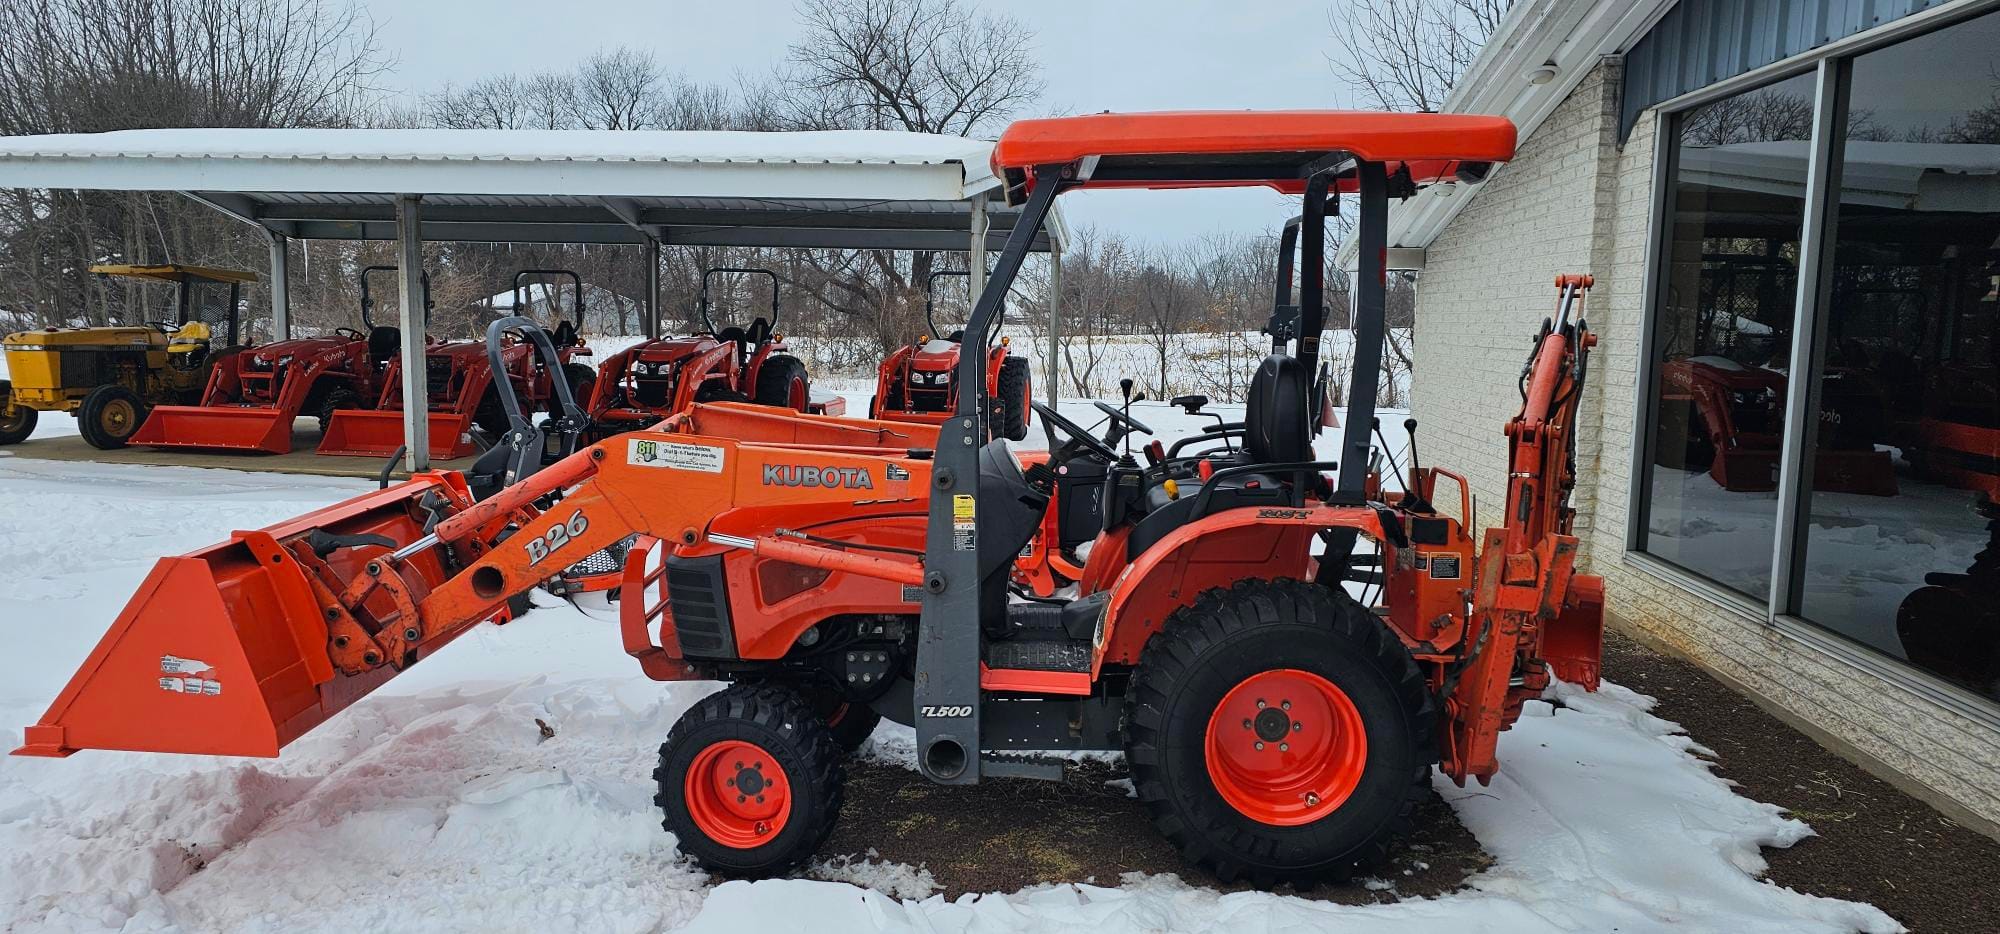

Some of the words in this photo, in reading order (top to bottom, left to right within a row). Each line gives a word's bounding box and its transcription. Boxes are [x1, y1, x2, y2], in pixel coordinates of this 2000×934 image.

[323, 350, 346, 362] Kubota
[638, 441, 656, 454] 811
[762, 464, 873, 489] KUBOTA
[524, 508, 589, 568] B26
